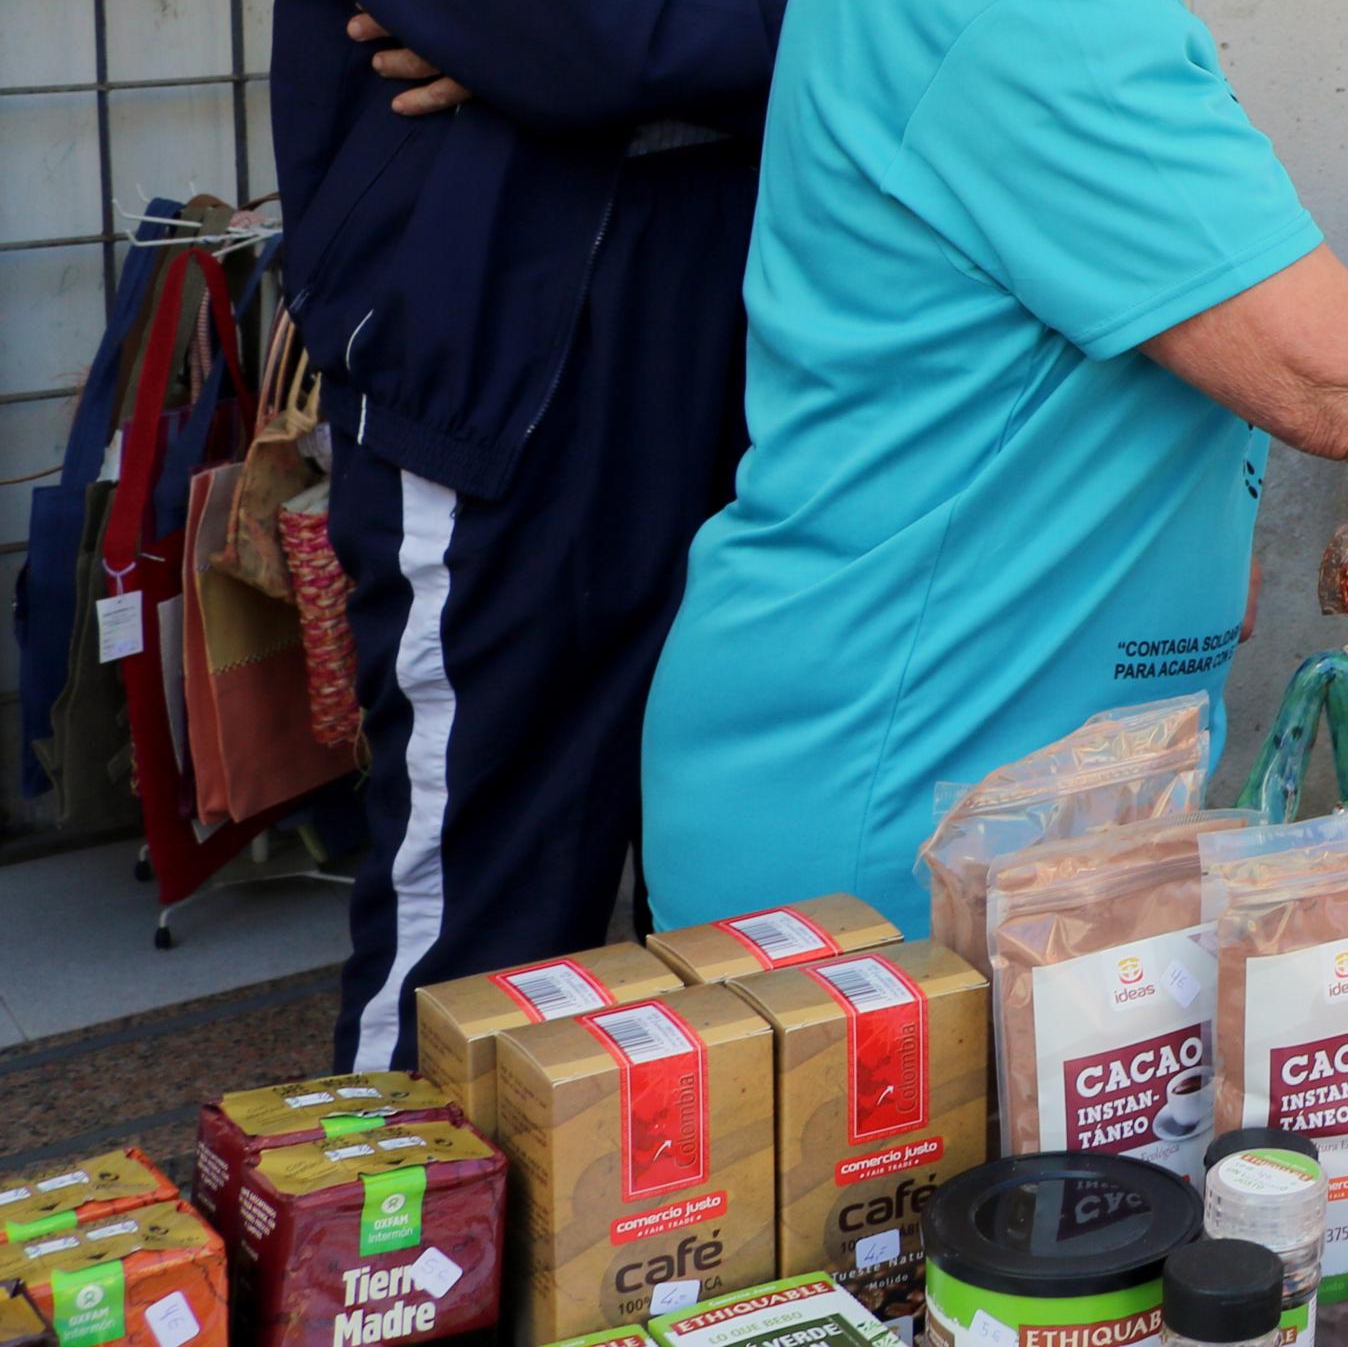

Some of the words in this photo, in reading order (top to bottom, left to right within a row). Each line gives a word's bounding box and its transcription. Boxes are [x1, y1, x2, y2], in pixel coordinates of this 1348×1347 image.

[1114, 663, 1155, 680] PARA
[1158, 657, 1212, 677] ACABAR
[1114, 983, 1155, 1004] ideas
[896, 1022, 917, 1114] Colombia
[1076, 1036, 1203, 1098] CACAO
[676, 1073, 695, 1169] Colombia
[1078, 1090, 1160, 1126] INSTAN-
[1078, 1116, 1149, 1149] TÁNEO
[840, 1150, 901, 1175] comercio
[903, 1140, 937, 1160] justo
[373, 1214, 409, 1230] OXFAM
[616, 1206, 682, 1233] comercio
[685, 1195, 720, 1217] justo
[615, 1229, 723, 1294] café
[868, 1273, 909, 1291] Molido
[69, 1306, 110, 1326] OXFAM
[334, 1300, 436, 1347] Madre
[678, 1282, 830, 1333] ETHIQUABLE
[730, 1322, 760, 1337] QUE
[763, 1310, 802, 1329] BEBO
[764, 1324, 842, 1347] VERDE
